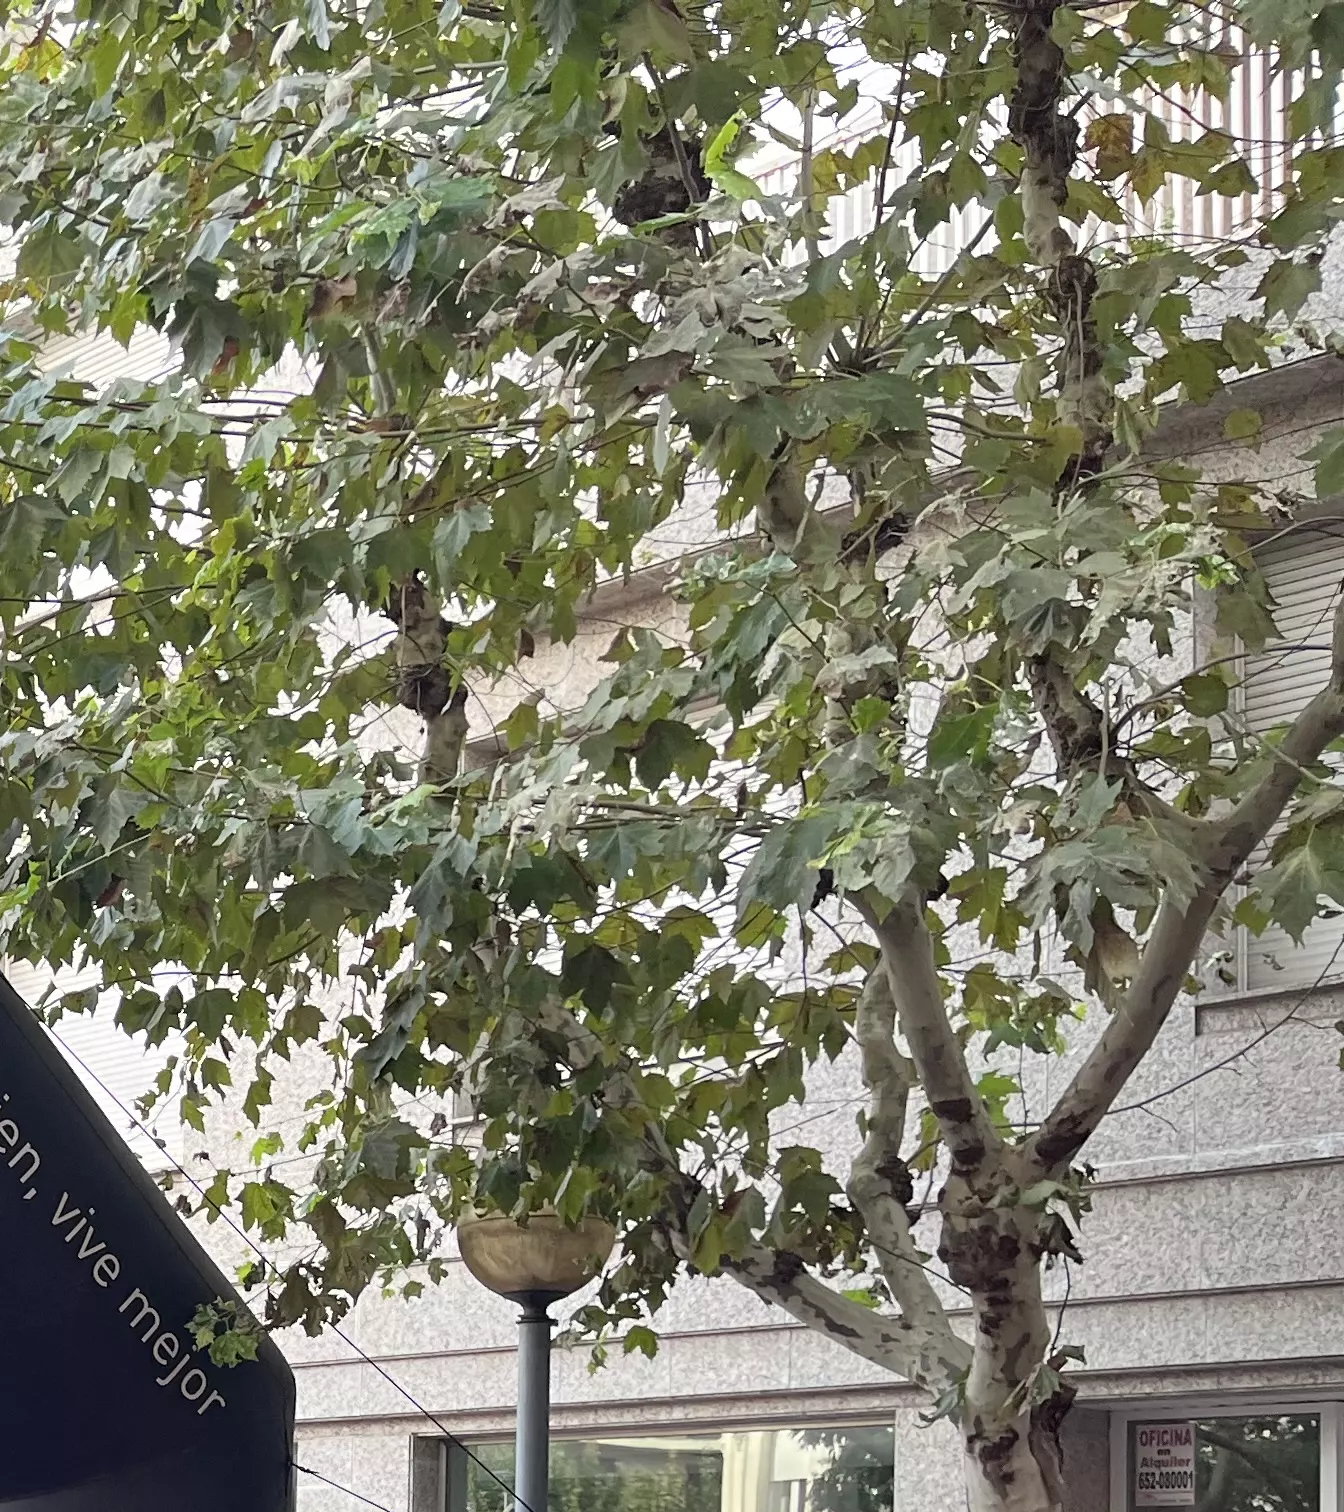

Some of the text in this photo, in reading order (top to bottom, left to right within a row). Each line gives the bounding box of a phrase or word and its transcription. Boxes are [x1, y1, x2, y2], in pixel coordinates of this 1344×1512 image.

[49, 1190, 123, 1290] vive
[117, 1286, 228, 1418] mejor
[1138, 1428, 1193, 1448] OFICINA
[1139, 1456, 1192, 1470] Alquiler
